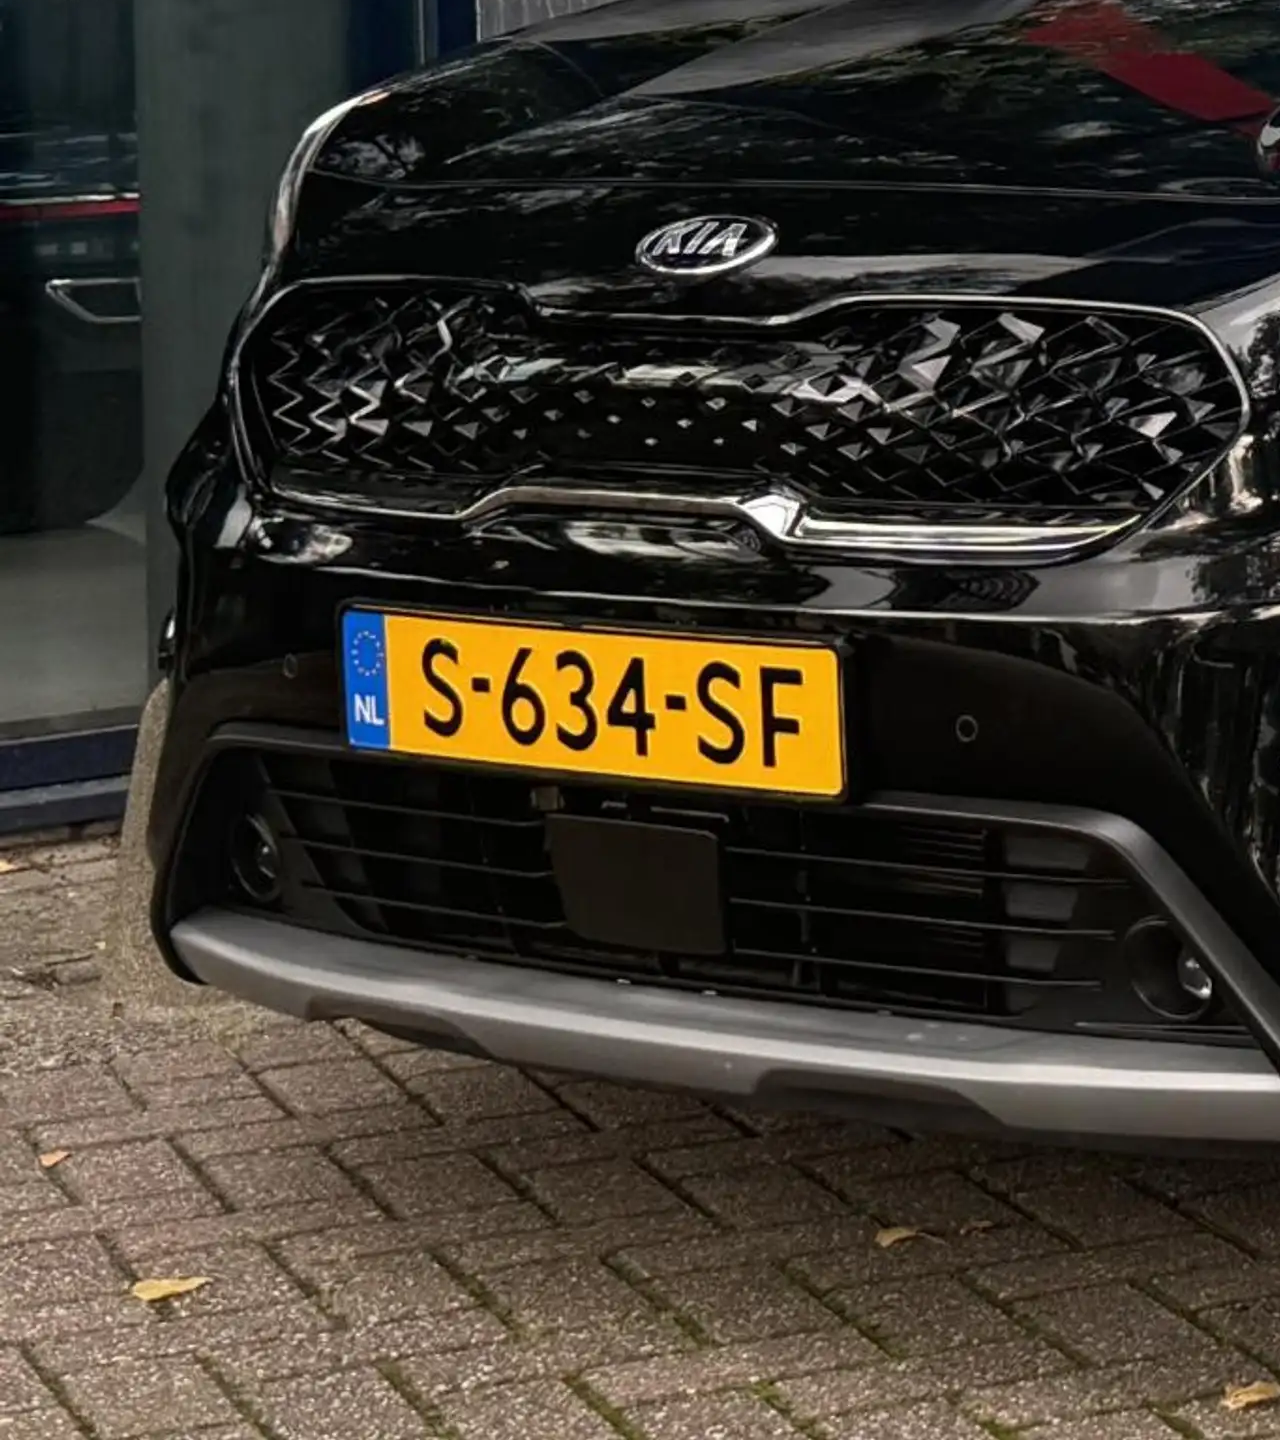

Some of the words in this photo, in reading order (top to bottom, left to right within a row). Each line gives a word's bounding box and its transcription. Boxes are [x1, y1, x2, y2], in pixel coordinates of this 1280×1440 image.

[651, 220, 748, 257] KIA
[354, 694, 385, 727] NL
[421, 636, 804, 768] S-634-SF
